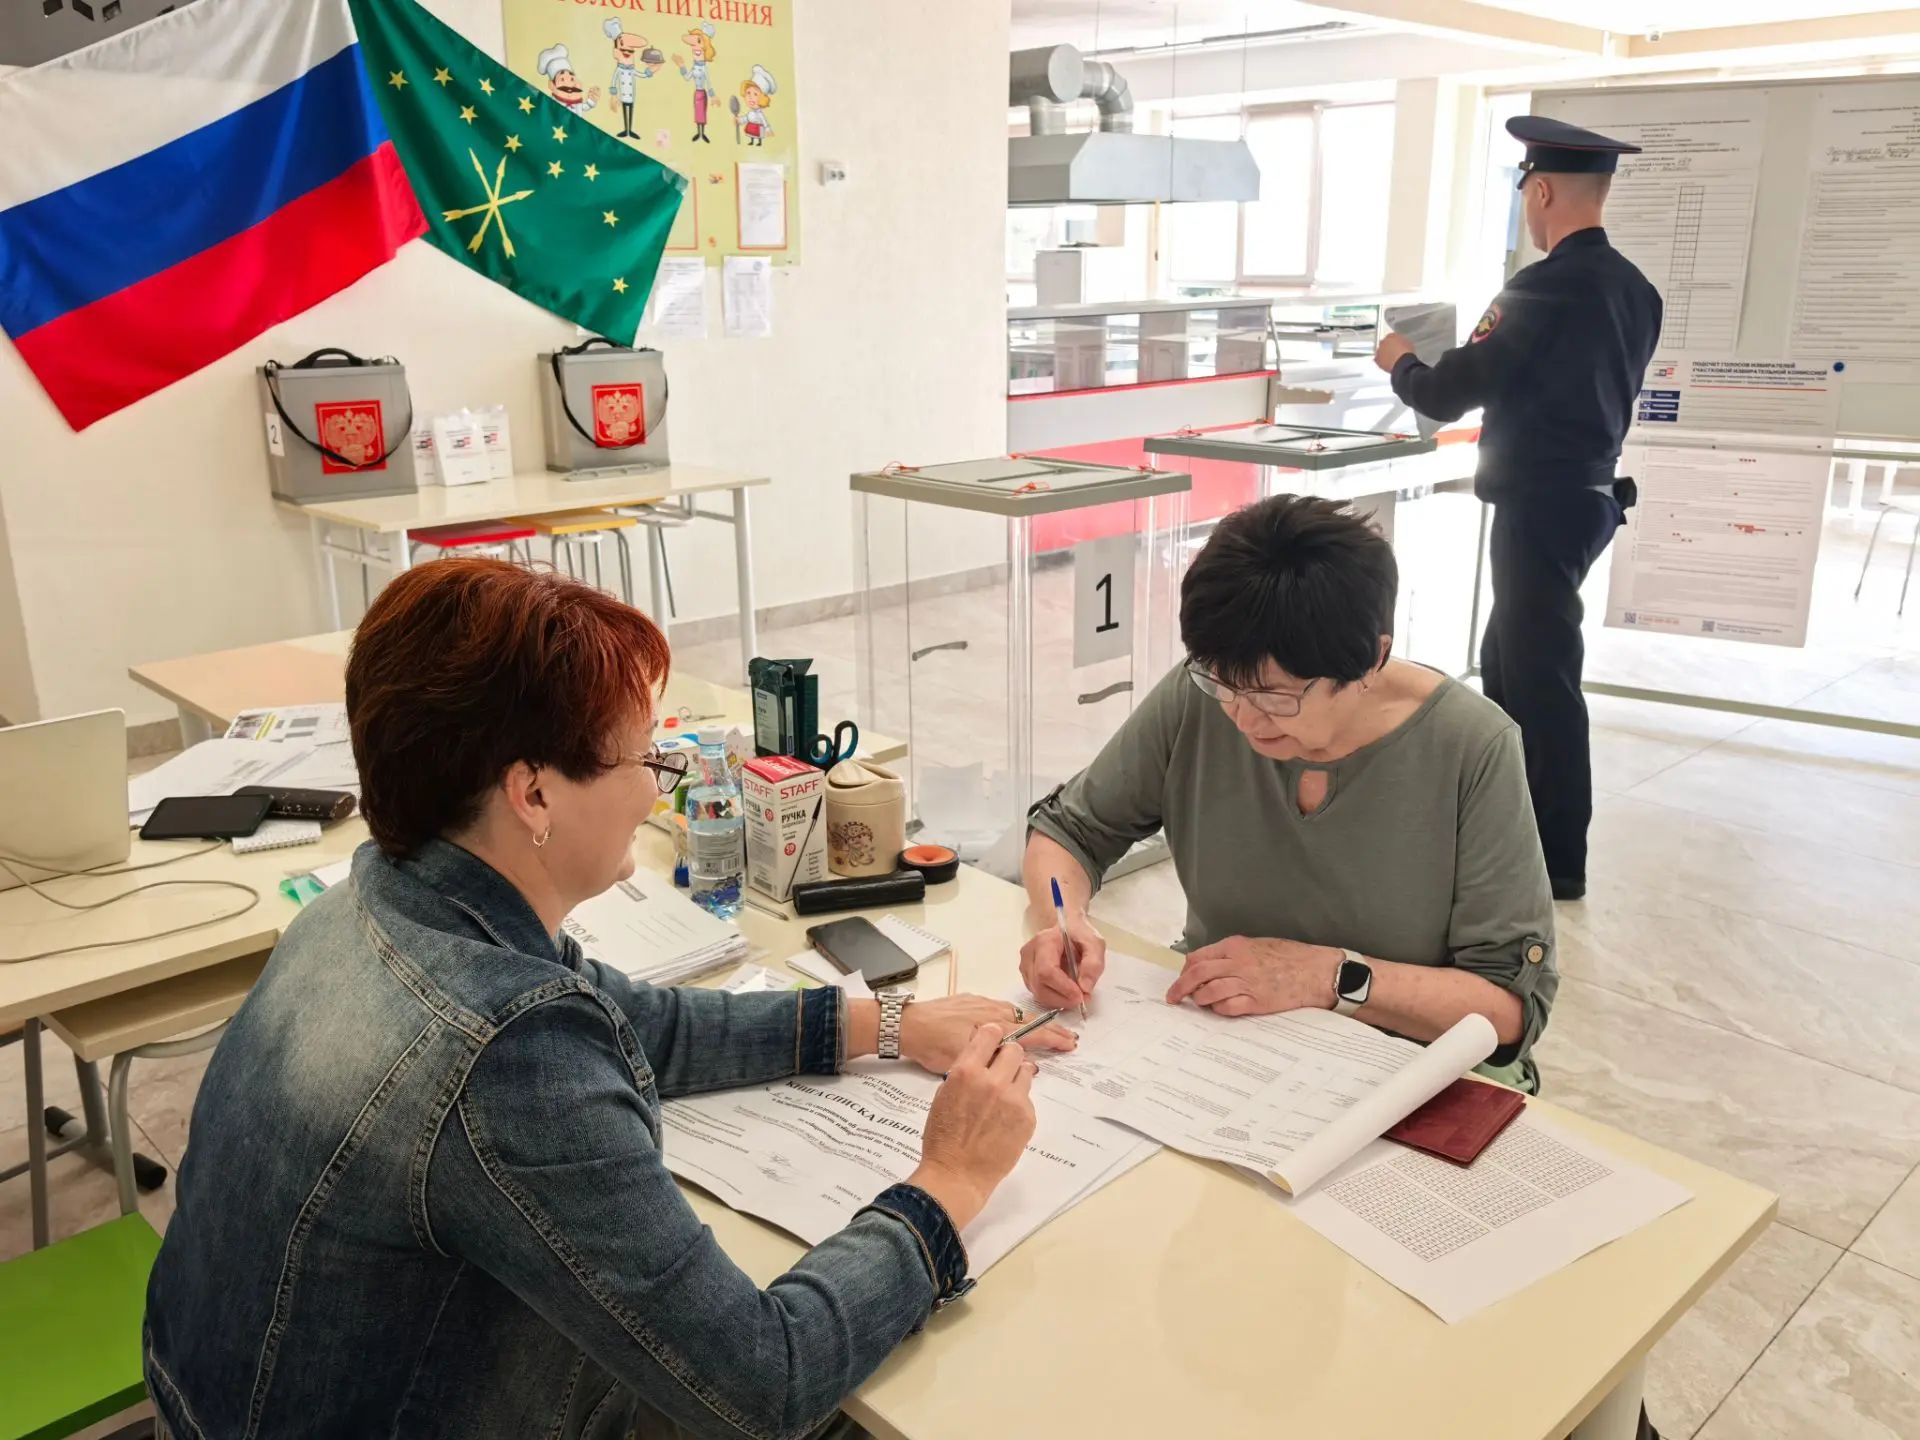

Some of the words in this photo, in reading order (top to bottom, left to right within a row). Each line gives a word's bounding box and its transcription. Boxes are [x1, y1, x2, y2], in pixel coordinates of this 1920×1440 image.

[656, 0, 773, 26] питания
[270, 424, 279, 444] 2
[1096, 573, 1119, 633] 1
[743, 778, 774, 798] STAFF
[780, 779, 820, 800] STAFF
[781, 808, 806, 823] РУЧКА
[785, 1081, 824, 1097] КНИГА
[825, 1093, 876, 1122] СПИСКА
[876, 1117, 924, 1140] ИЗБИР
